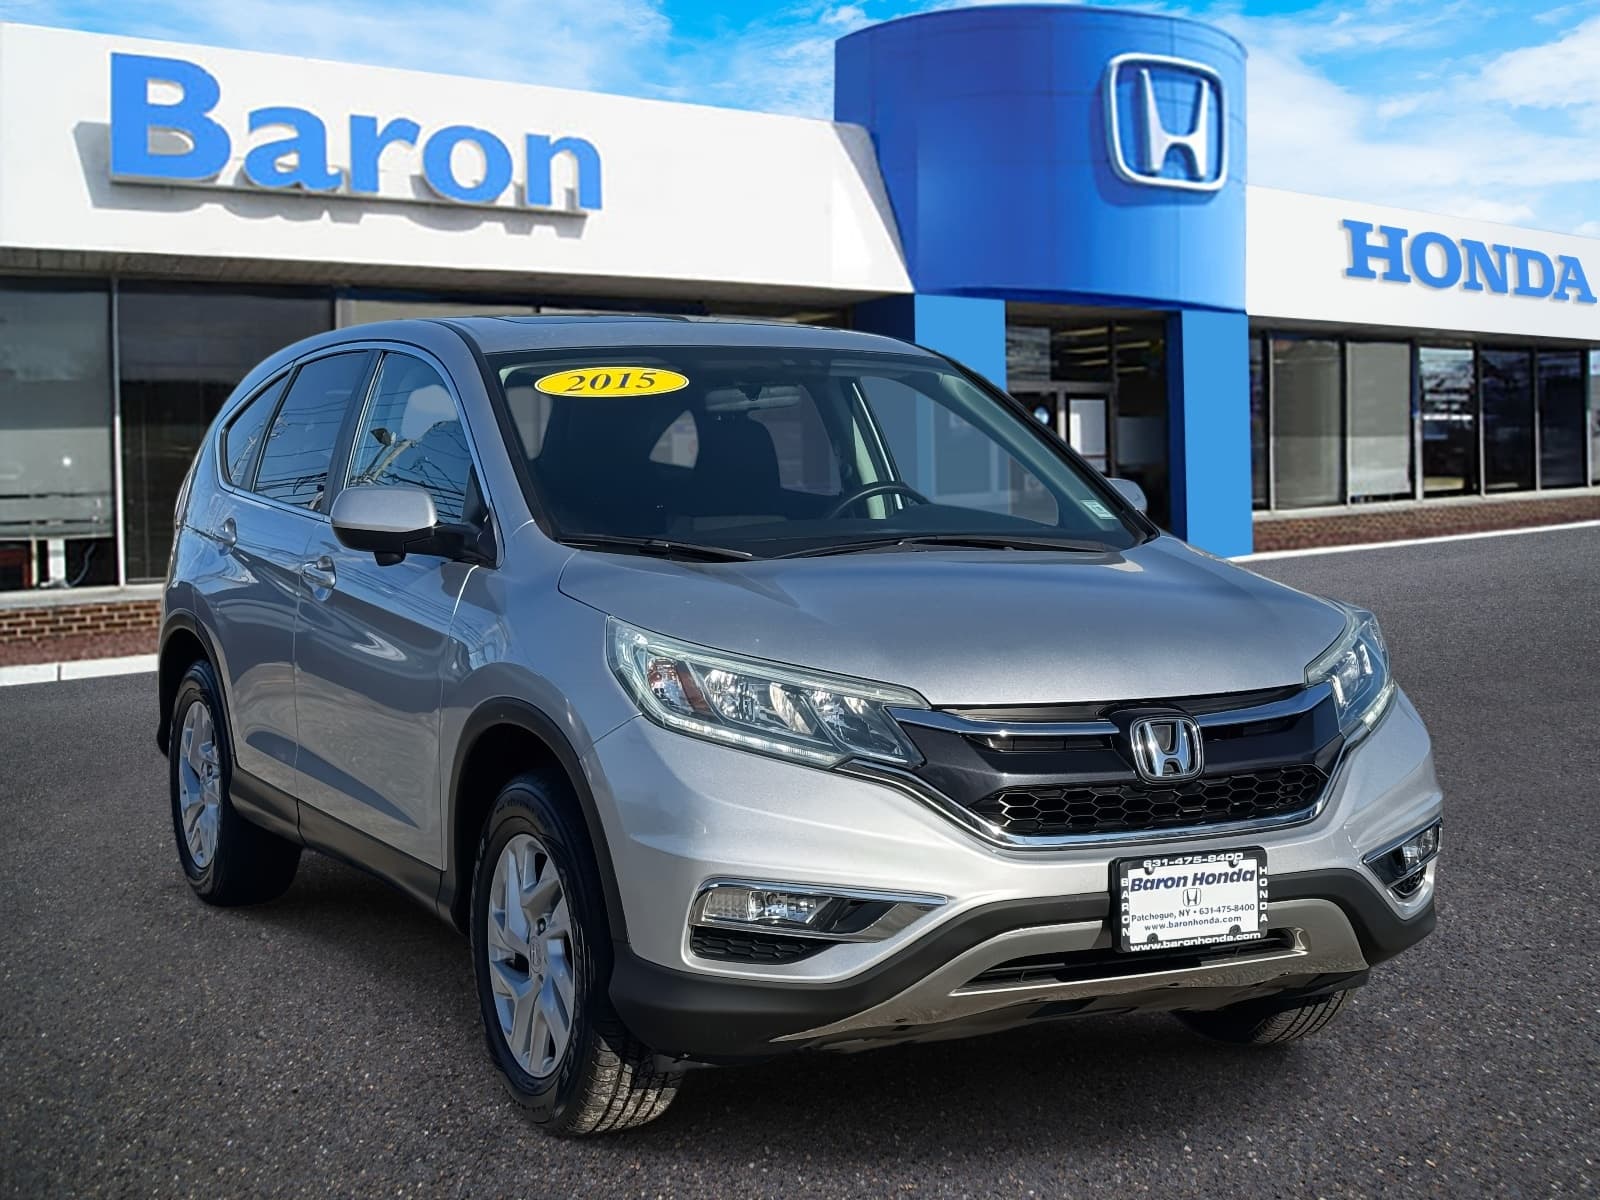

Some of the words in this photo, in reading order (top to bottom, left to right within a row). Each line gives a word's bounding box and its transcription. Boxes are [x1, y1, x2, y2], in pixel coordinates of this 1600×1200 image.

[110, 52, 603, 212] Baron
[1342, 219, 1598, 304] HONDA
[564, 372, 657, 392] 2015
[1130, 875, 1187, 892] Baron
[1192, 868, 1256, 888] Honda
[1259, 866, 1268, 922] HONDA
[1178, 908, 1191, 918] NY
[1199, 904, 1255, 915] 631-475-8400
[1144, 915, 1242, 931] www.baronhonda.com
[1130, 932, 1261, 951] www.baronhonda.com
